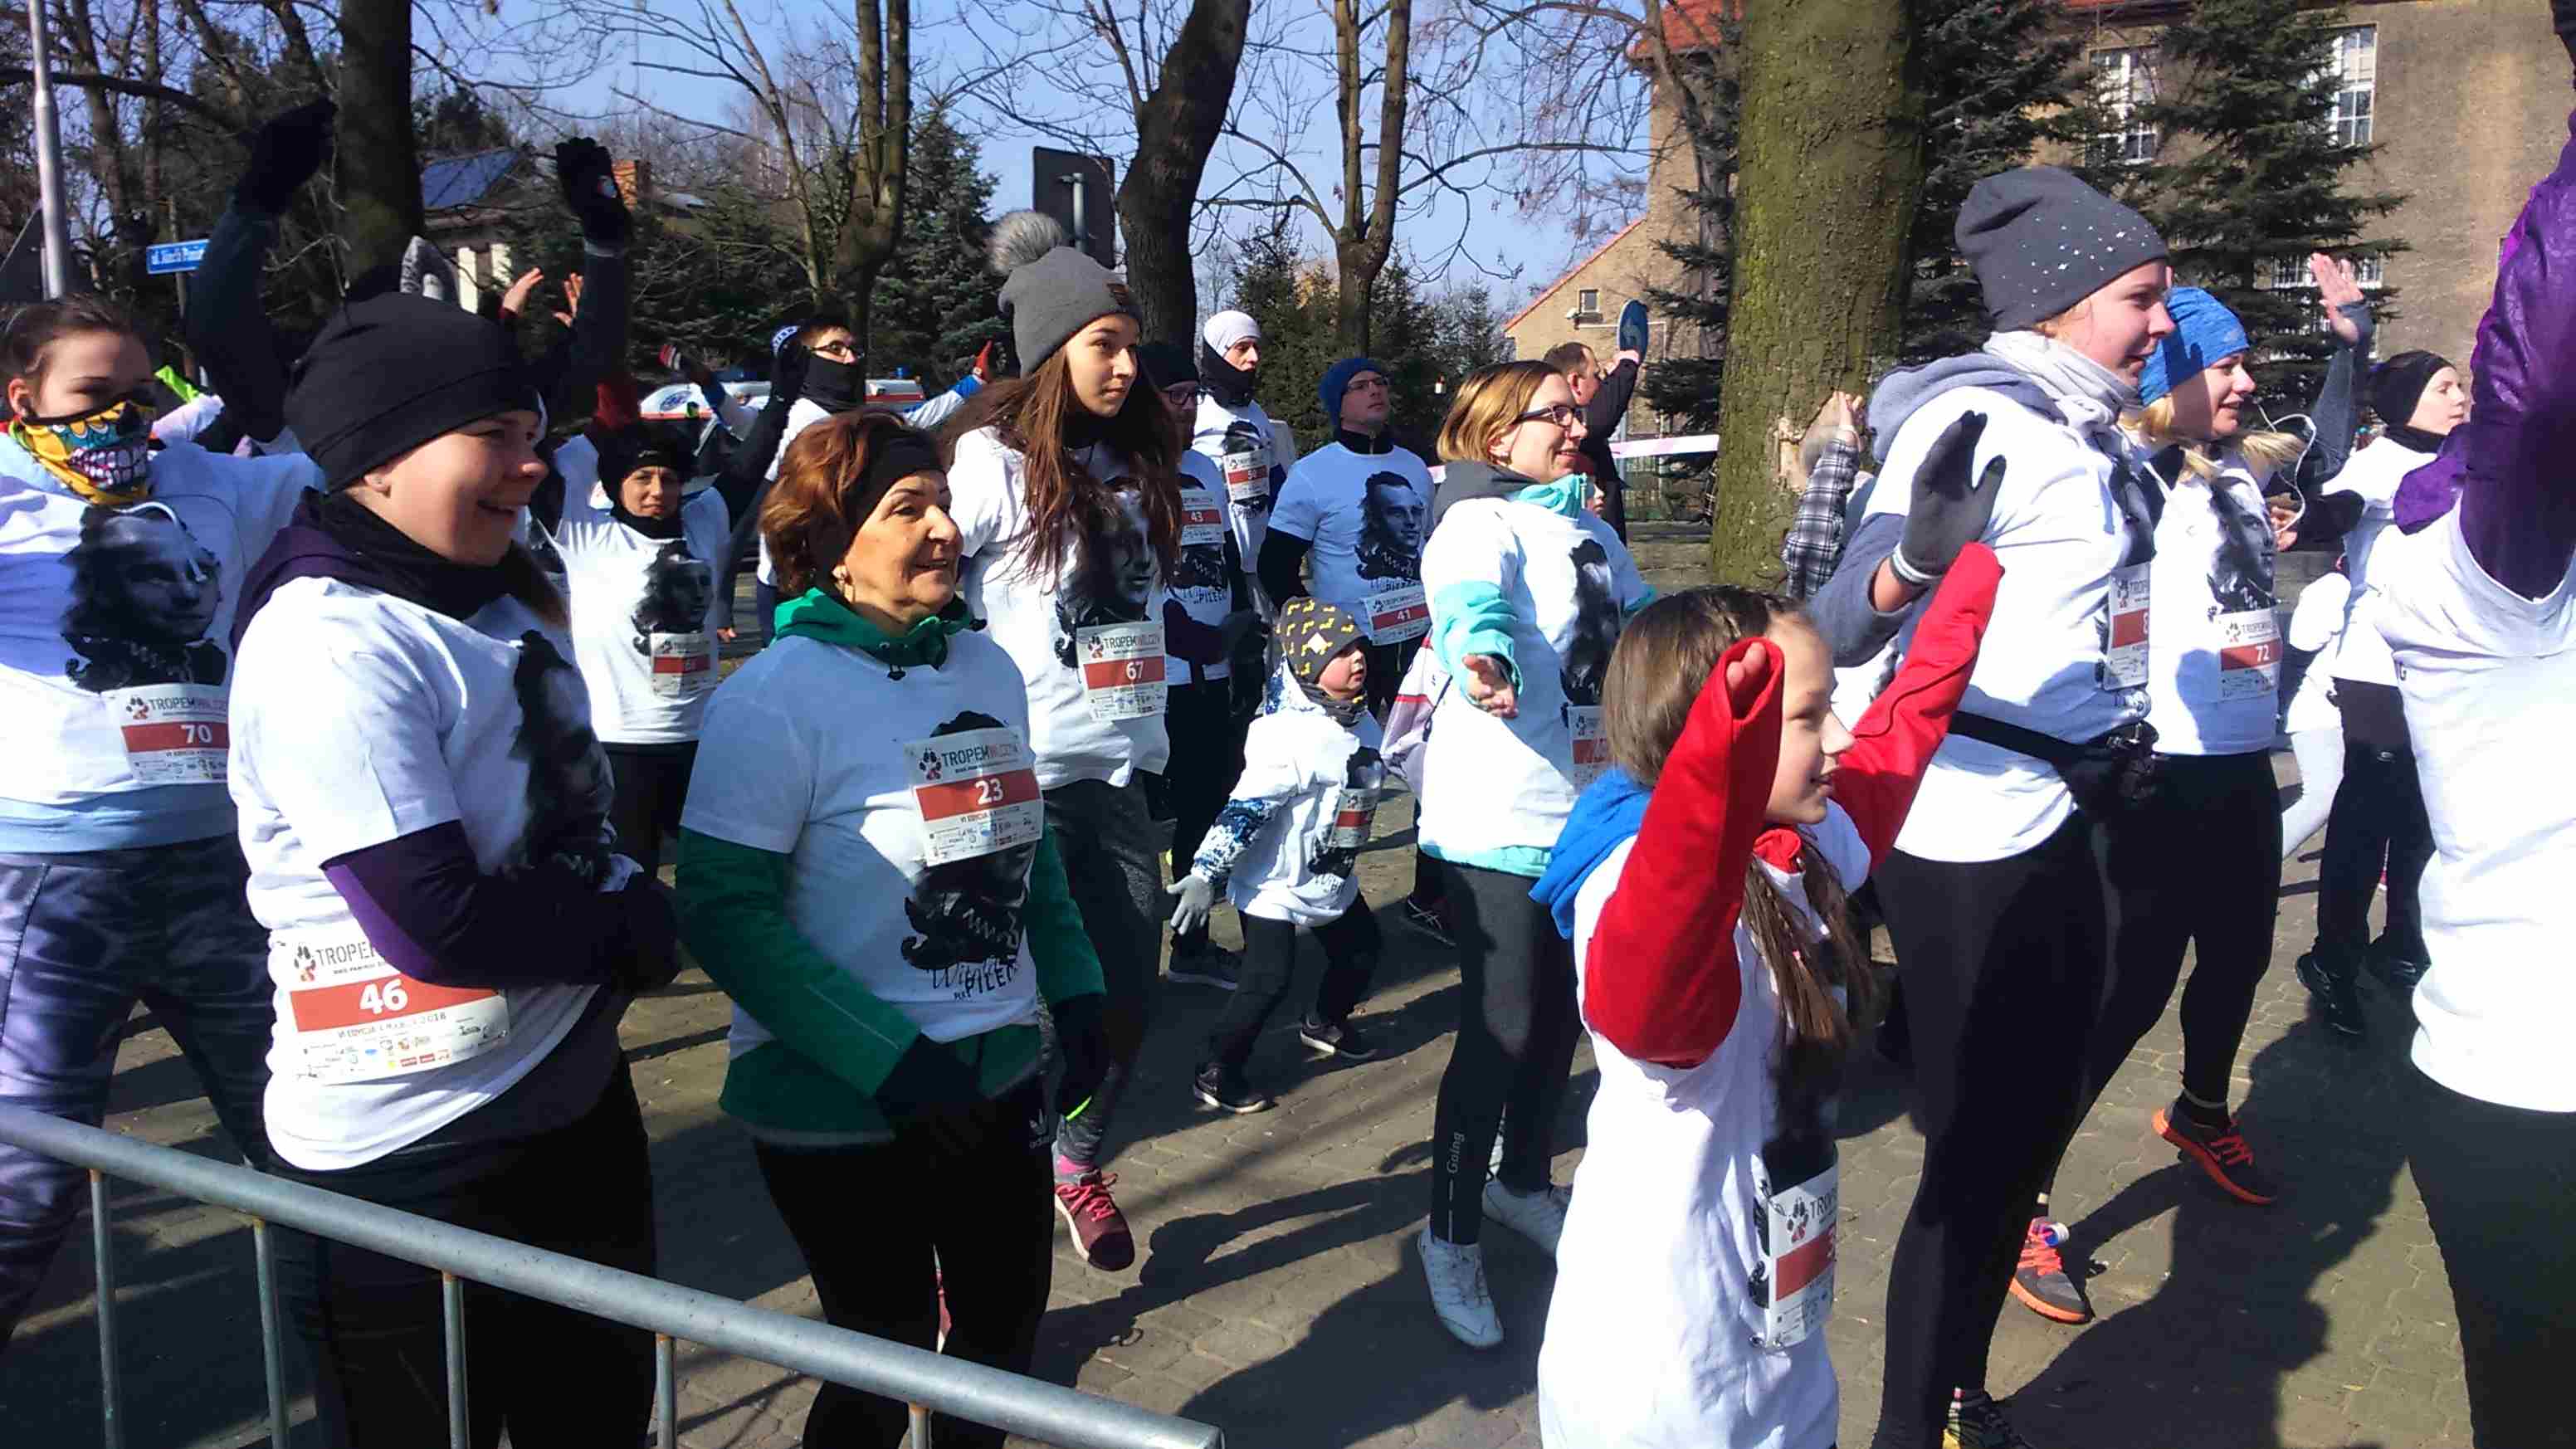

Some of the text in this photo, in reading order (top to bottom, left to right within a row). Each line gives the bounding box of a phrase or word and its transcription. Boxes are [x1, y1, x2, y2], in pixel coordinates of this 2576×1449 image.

[1191, 511, 1203, 522] 43
[1397, 608, 1412, 621] 41
[2255, 644, 2271, 662] 72
[1125, 661, 1144, 681] 67
[180, 724, 213, 744] 70
[974, 778, 1004, 806] 23
[359, 979, 409, 1015] 46
